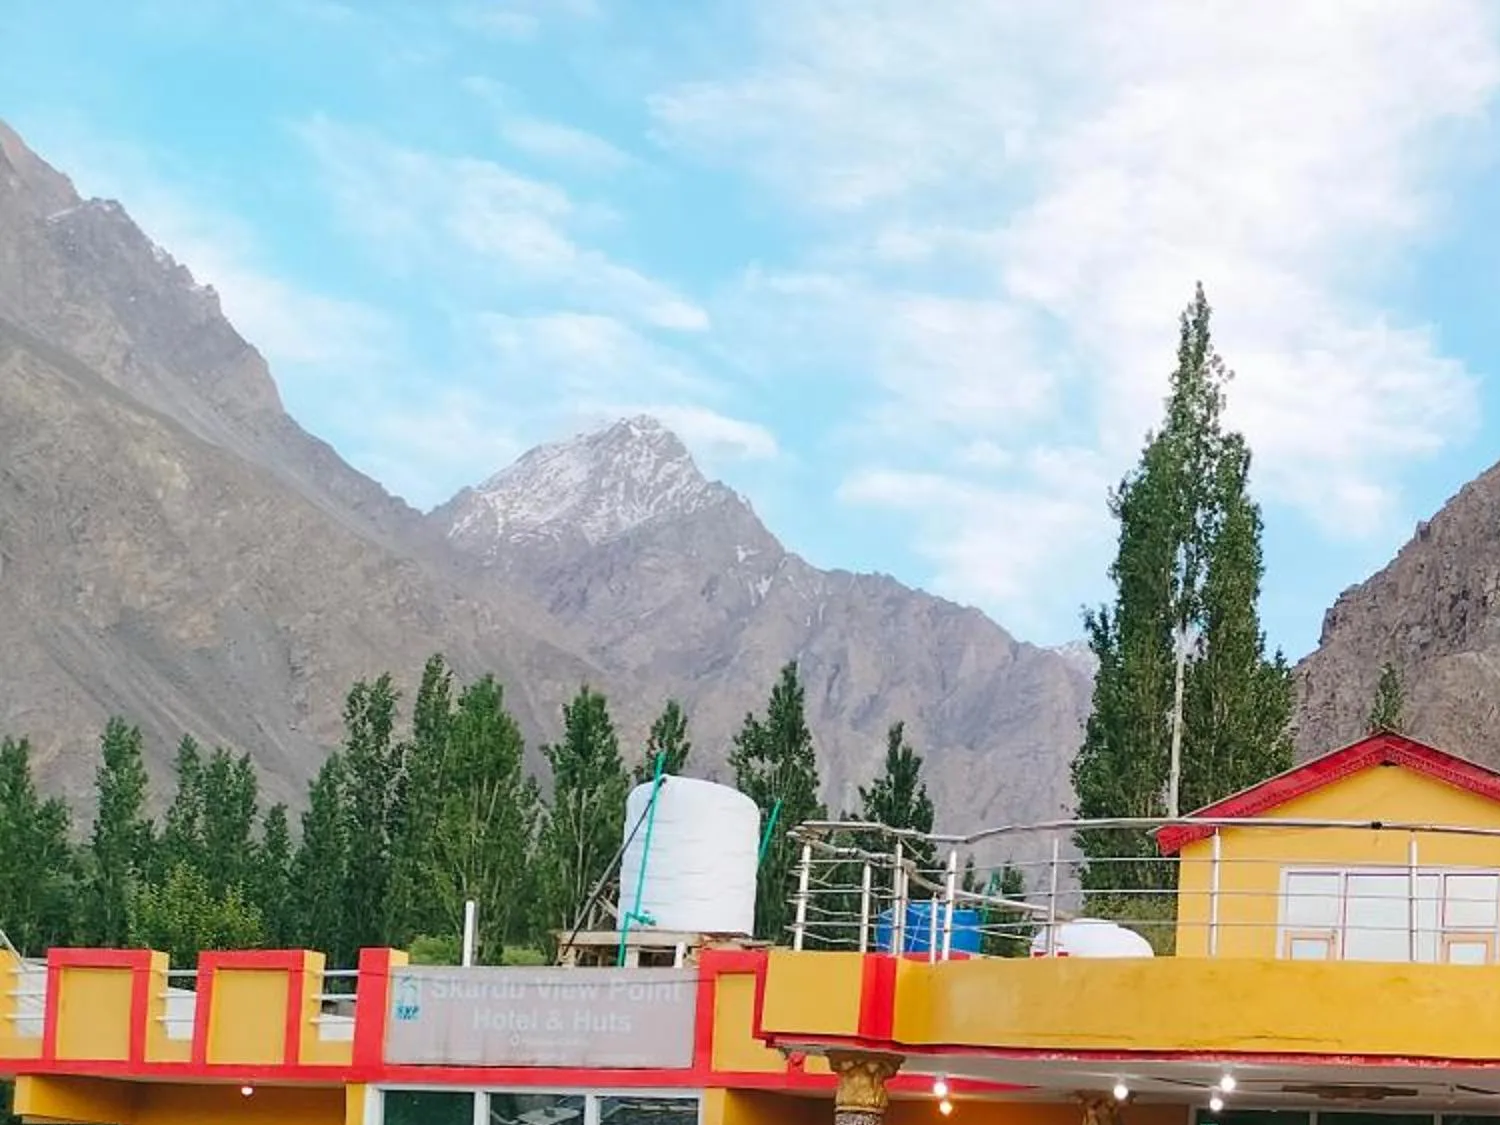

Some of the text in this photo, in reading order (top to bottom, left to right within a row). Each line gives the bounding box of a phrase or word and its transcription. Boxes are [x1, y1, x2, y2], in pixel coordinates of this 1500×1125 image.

[432, 976, 682, 1002] Skardu View Point
[473, 1008, 633, 1033] Hotel & Huts
